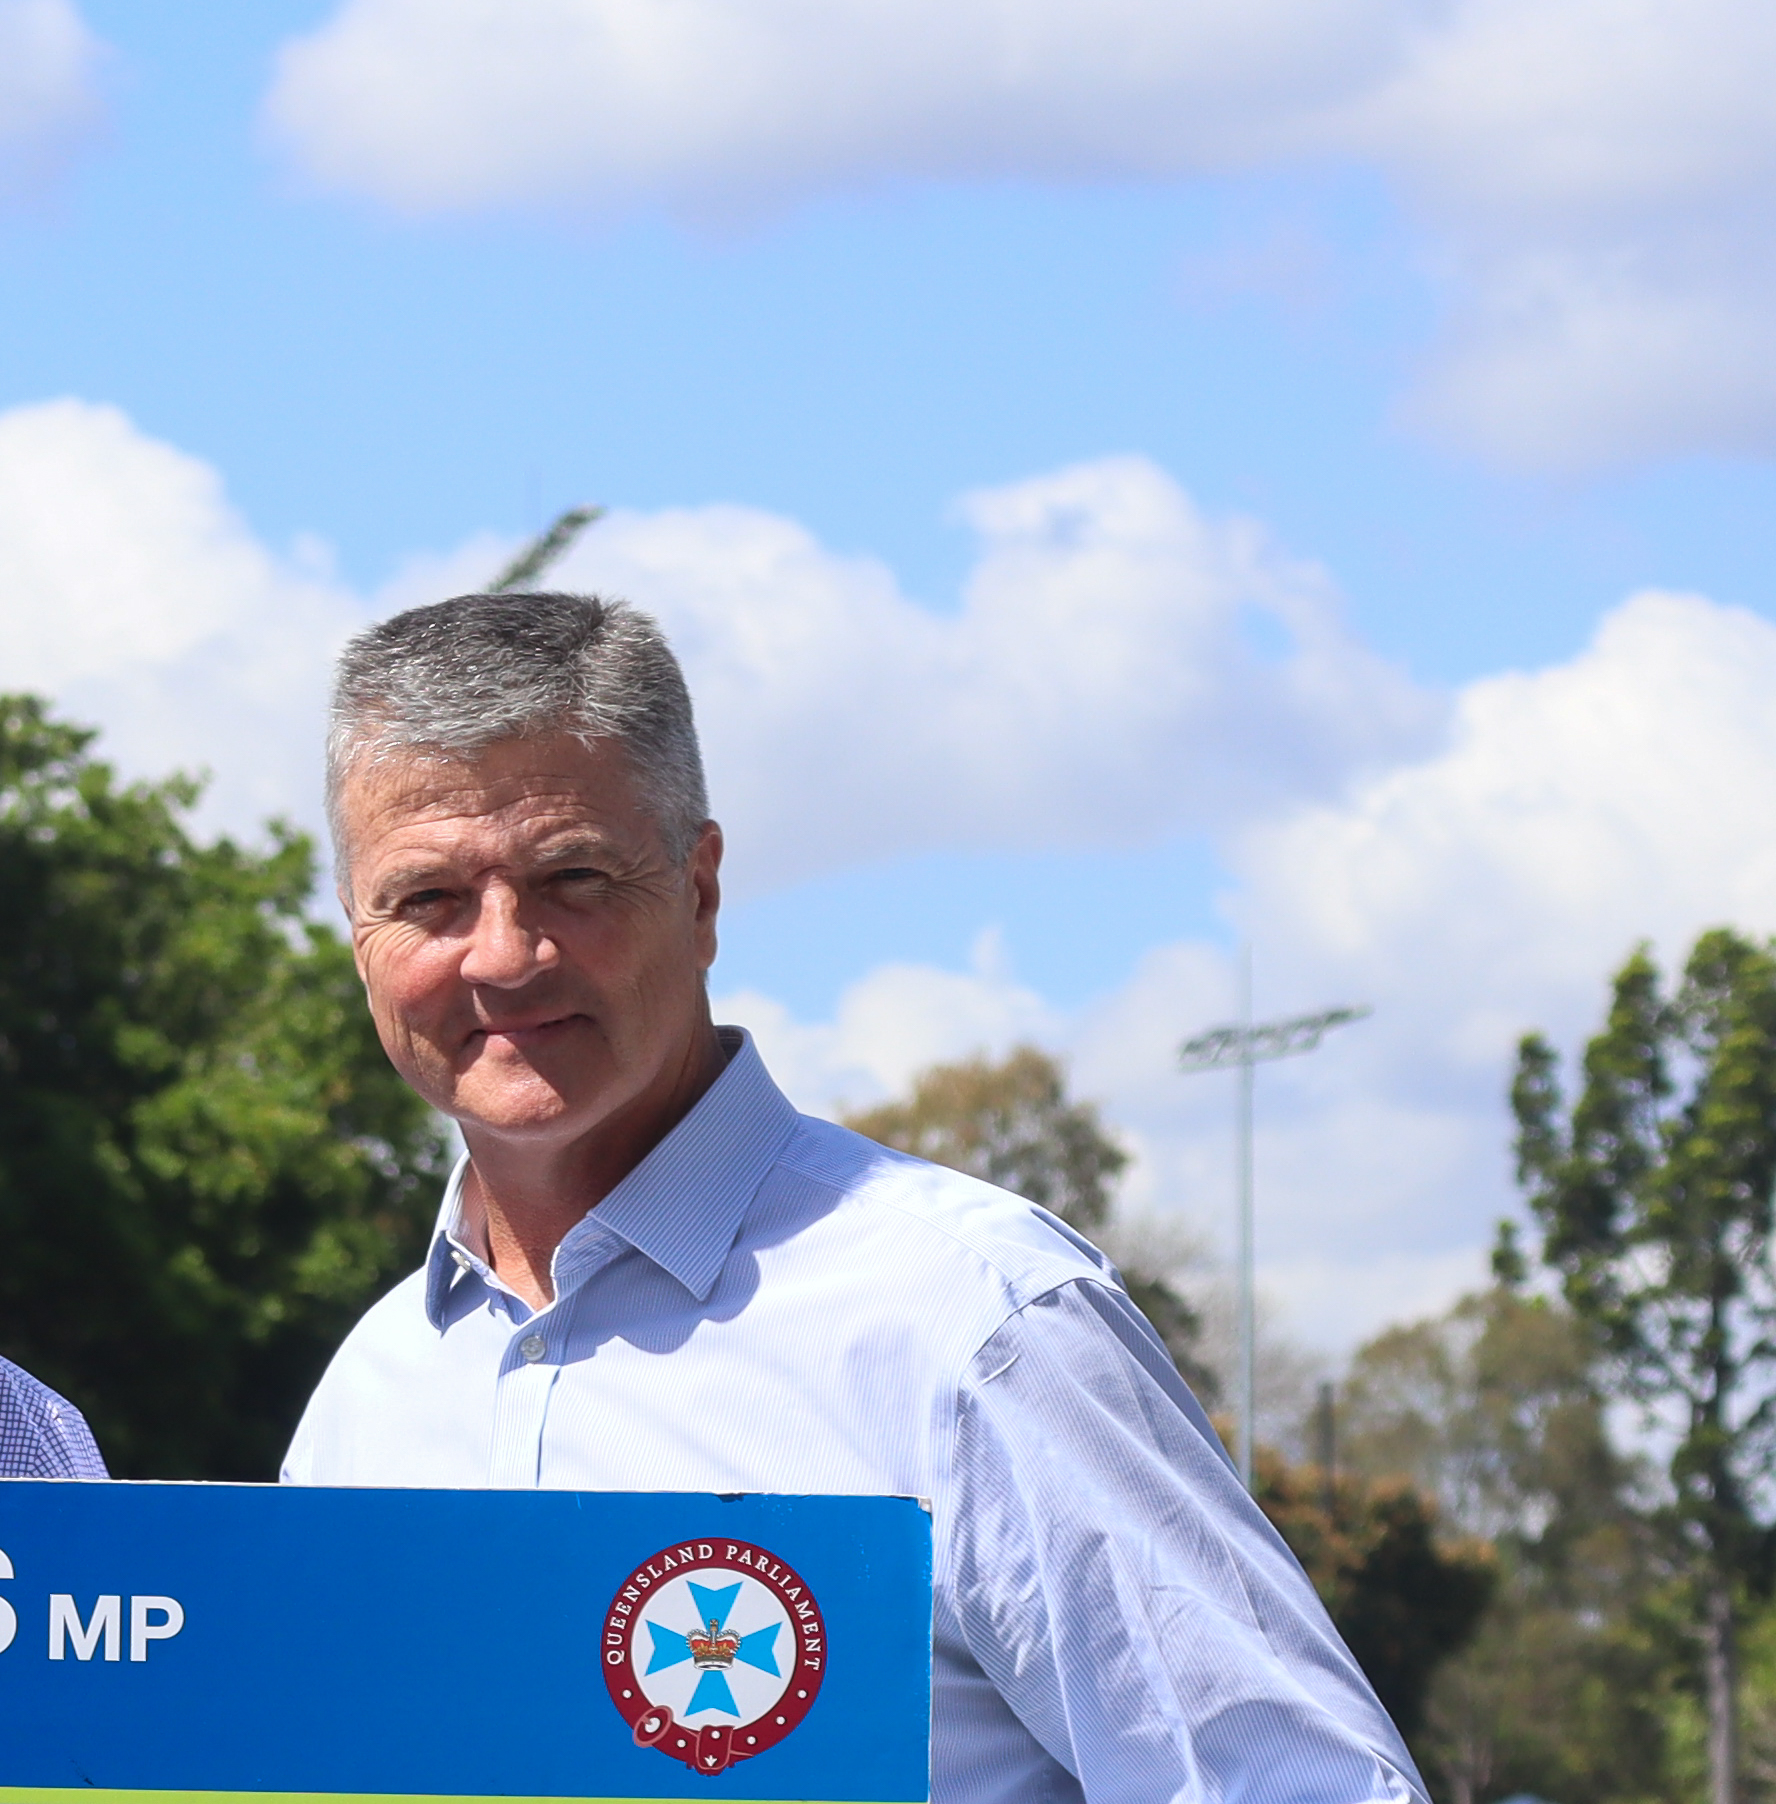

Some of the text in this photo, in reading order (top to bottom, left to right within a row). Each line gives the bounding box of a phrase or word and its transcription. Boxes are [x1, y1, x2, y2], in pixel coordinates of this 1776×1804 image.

[49, 1594, 184, 1662] MP
[607, 1544, 822, 1671] QUEENSLAND PARLIAMENT
